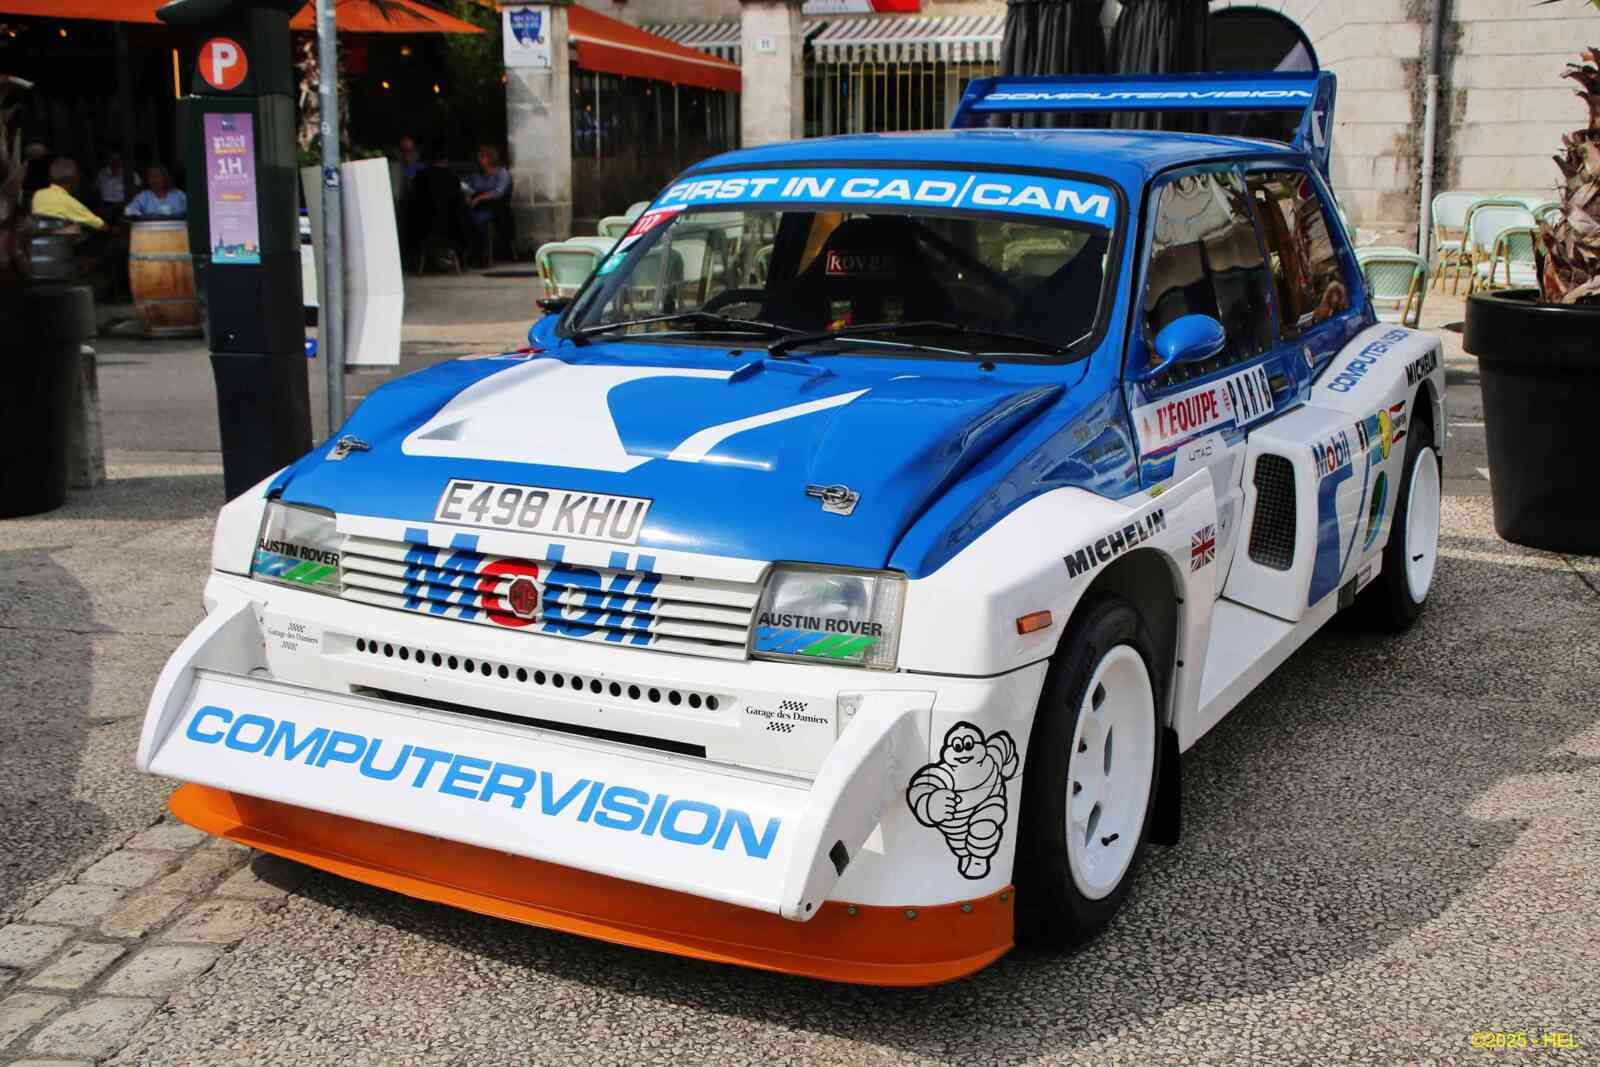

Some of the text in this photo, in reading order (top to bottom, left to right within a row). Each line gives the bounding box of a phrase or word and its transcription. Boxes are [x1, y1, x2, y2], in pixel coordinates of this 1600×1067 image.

[212, 42, 238, 84] P
[985, 90, 1313, 101] COMPUTERVISION
[217, 157, 243, 176] 1H
[659, 175, 1110, 218] FIRST IN CAD/CAM
[1405, 349, 1438, 387] MICHELIN
[1156, 389, 1219, 441] L'ÉQUIPE
[1226, 366, 1272, 424] PARIS
[1311, 430, 1351, 478] Mobil
[439, 482, 644, 540] E498 KHU
[257, 538, 340, 567] AUSTIN ROVER
[1063, 508, 1167, 579] MICHELIN
[402, 527, 661, 646] Mobil
[758, 611, 883, 637] AUSTIN ROVER
[745, 705, 829, 725] Garage des Damiers
[185, 705, 782, 860] COMPUTERVISION
